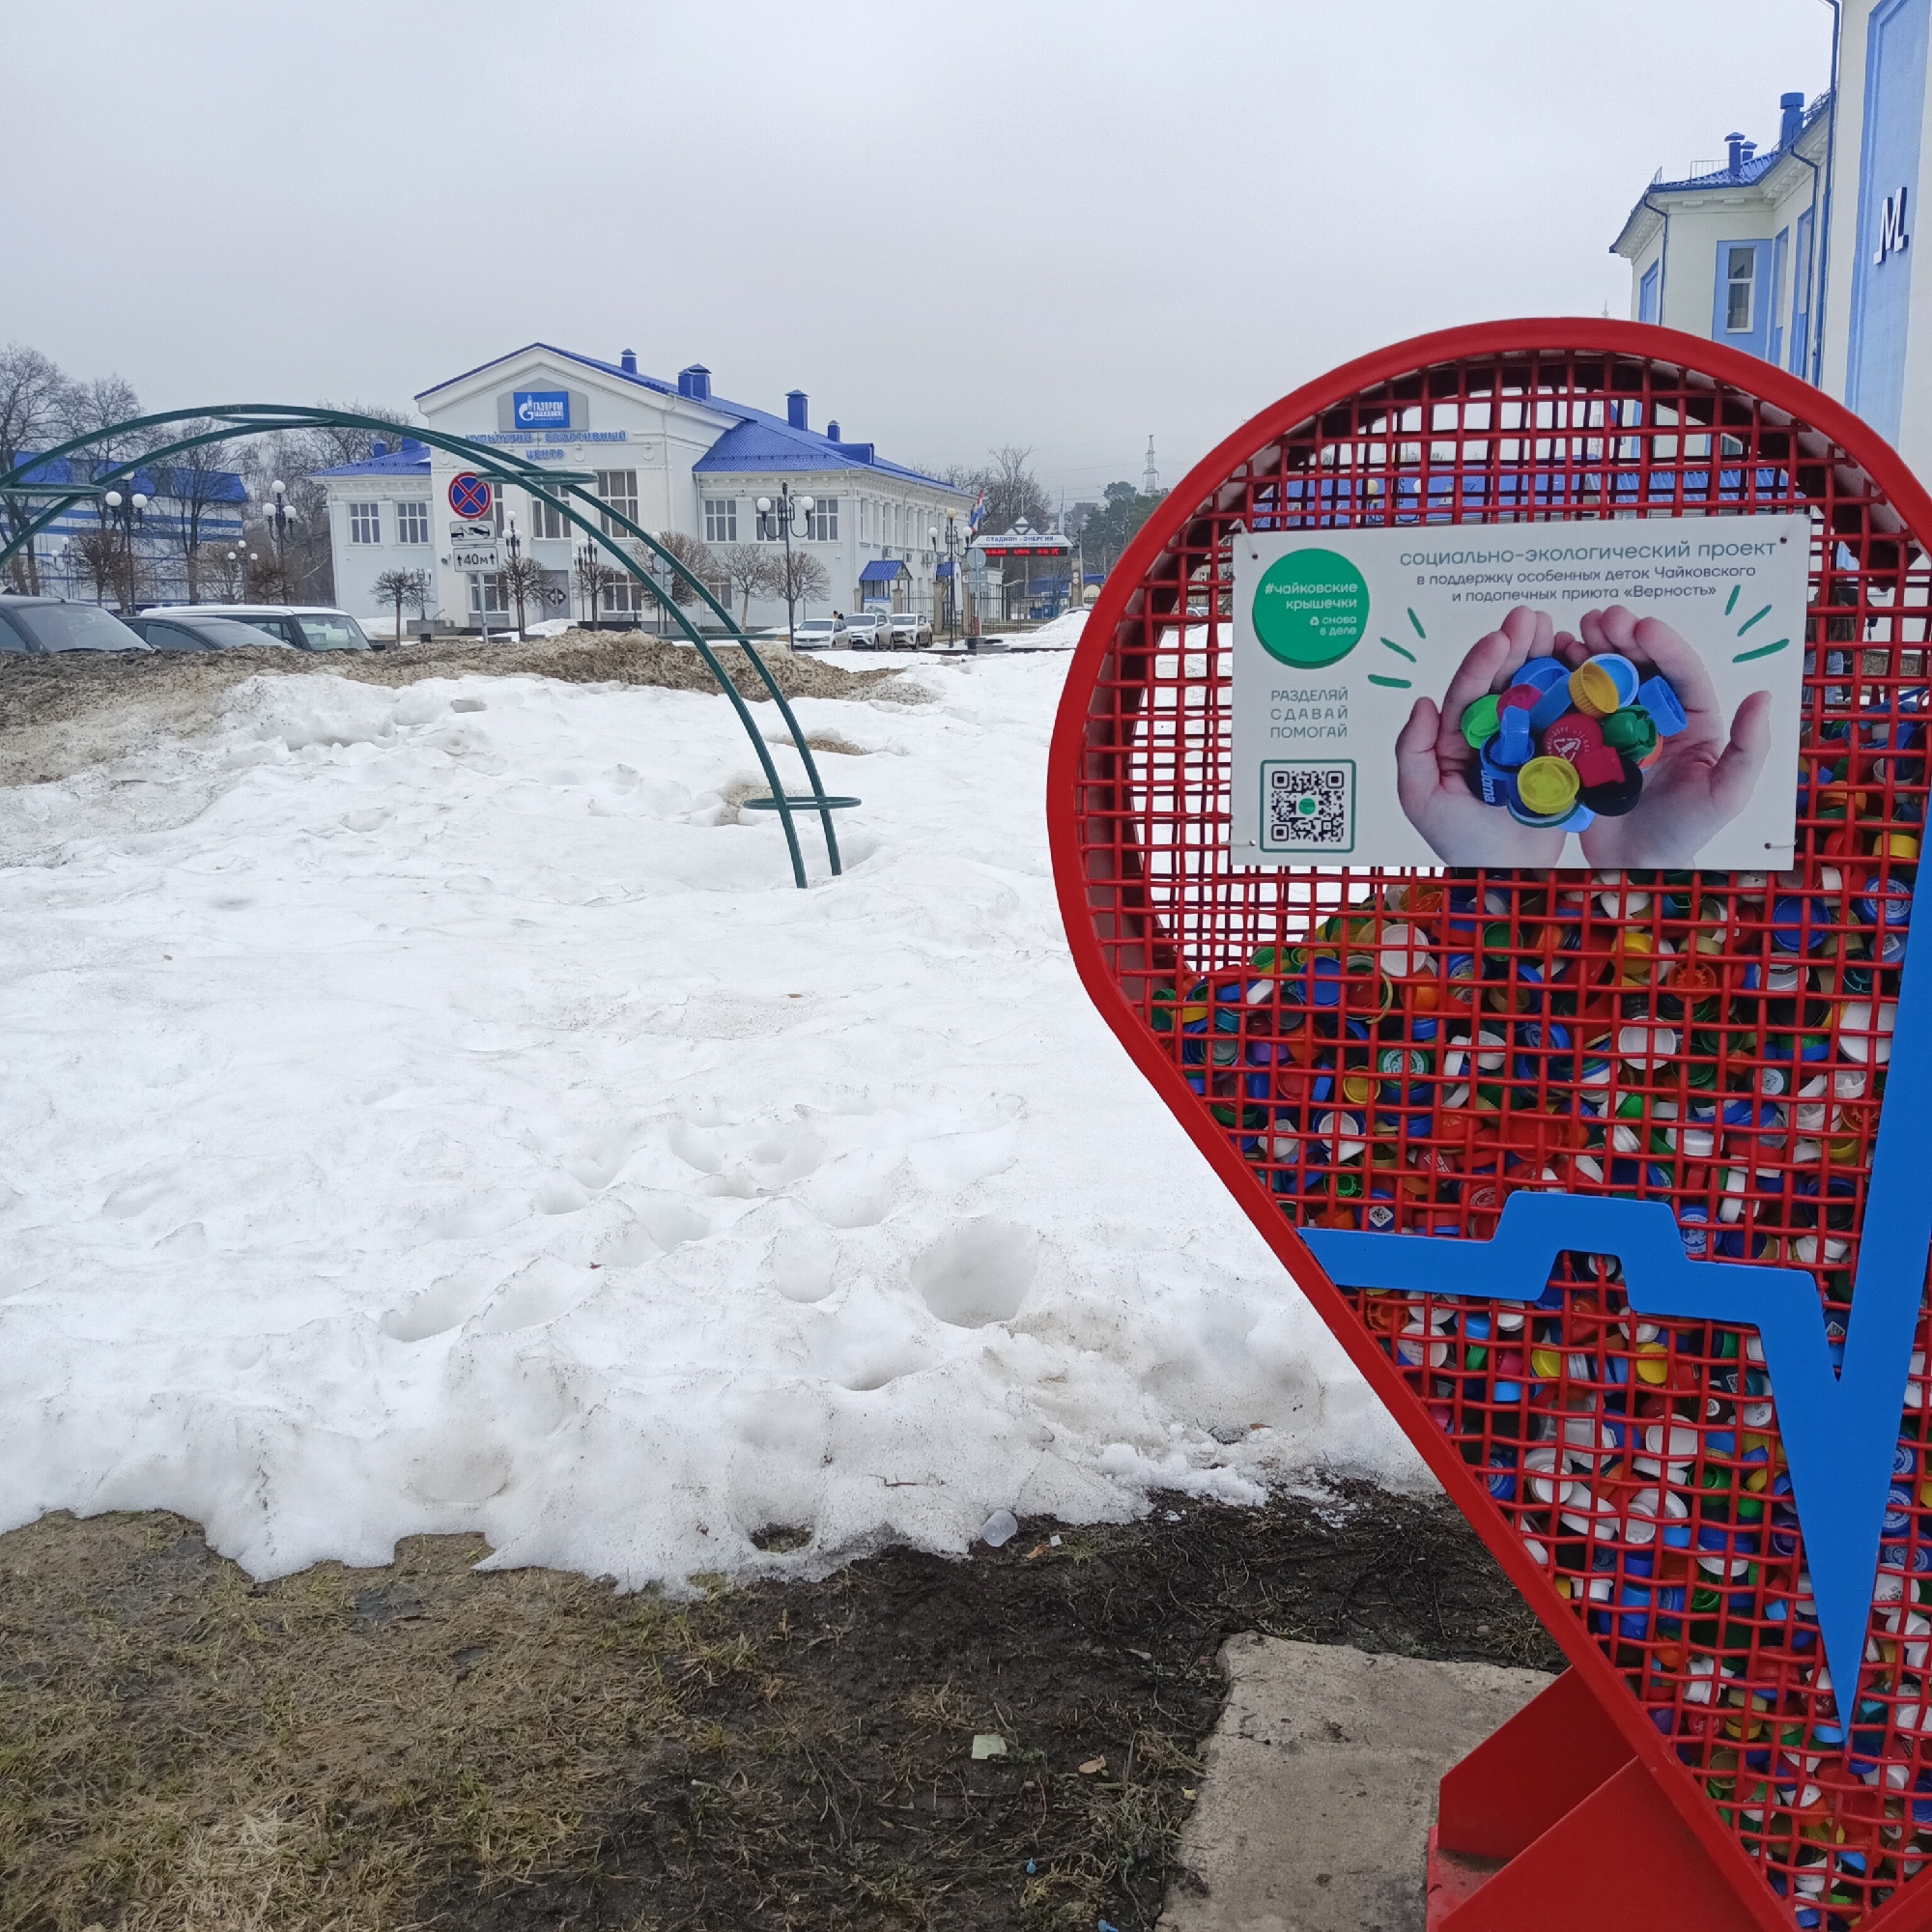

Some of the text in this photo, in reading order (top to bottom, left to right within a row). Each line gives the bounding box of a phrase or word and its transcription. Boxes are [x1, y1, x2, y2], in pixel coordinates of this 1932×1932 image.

[545, 431, 627, 442] СПОРТИВНЫЙ
[526, 449, 564, 461] ЦЕНТР
[1400, 540, 1777, 567] социально-экологический проект
[1416, 565, 1756, 587] в поддержку особенных деток Чайковского
[1264, 582, 1358, 595] #чайковские
[1452, 584, 1717, 604] и подопечных приюта «Верность»
[1286, 598, 1357, 611] крышечки
[1321, 616, 1357, 625] снова
[1328, 626, 1357, 637] деле
[1270, 686, 1349, 703] РАЗДЕЛЯЙ
[1270, 704, 1349, 722] СДАВАЙ
[1270, 723, 1348, 739] ПОМОГАЙ
